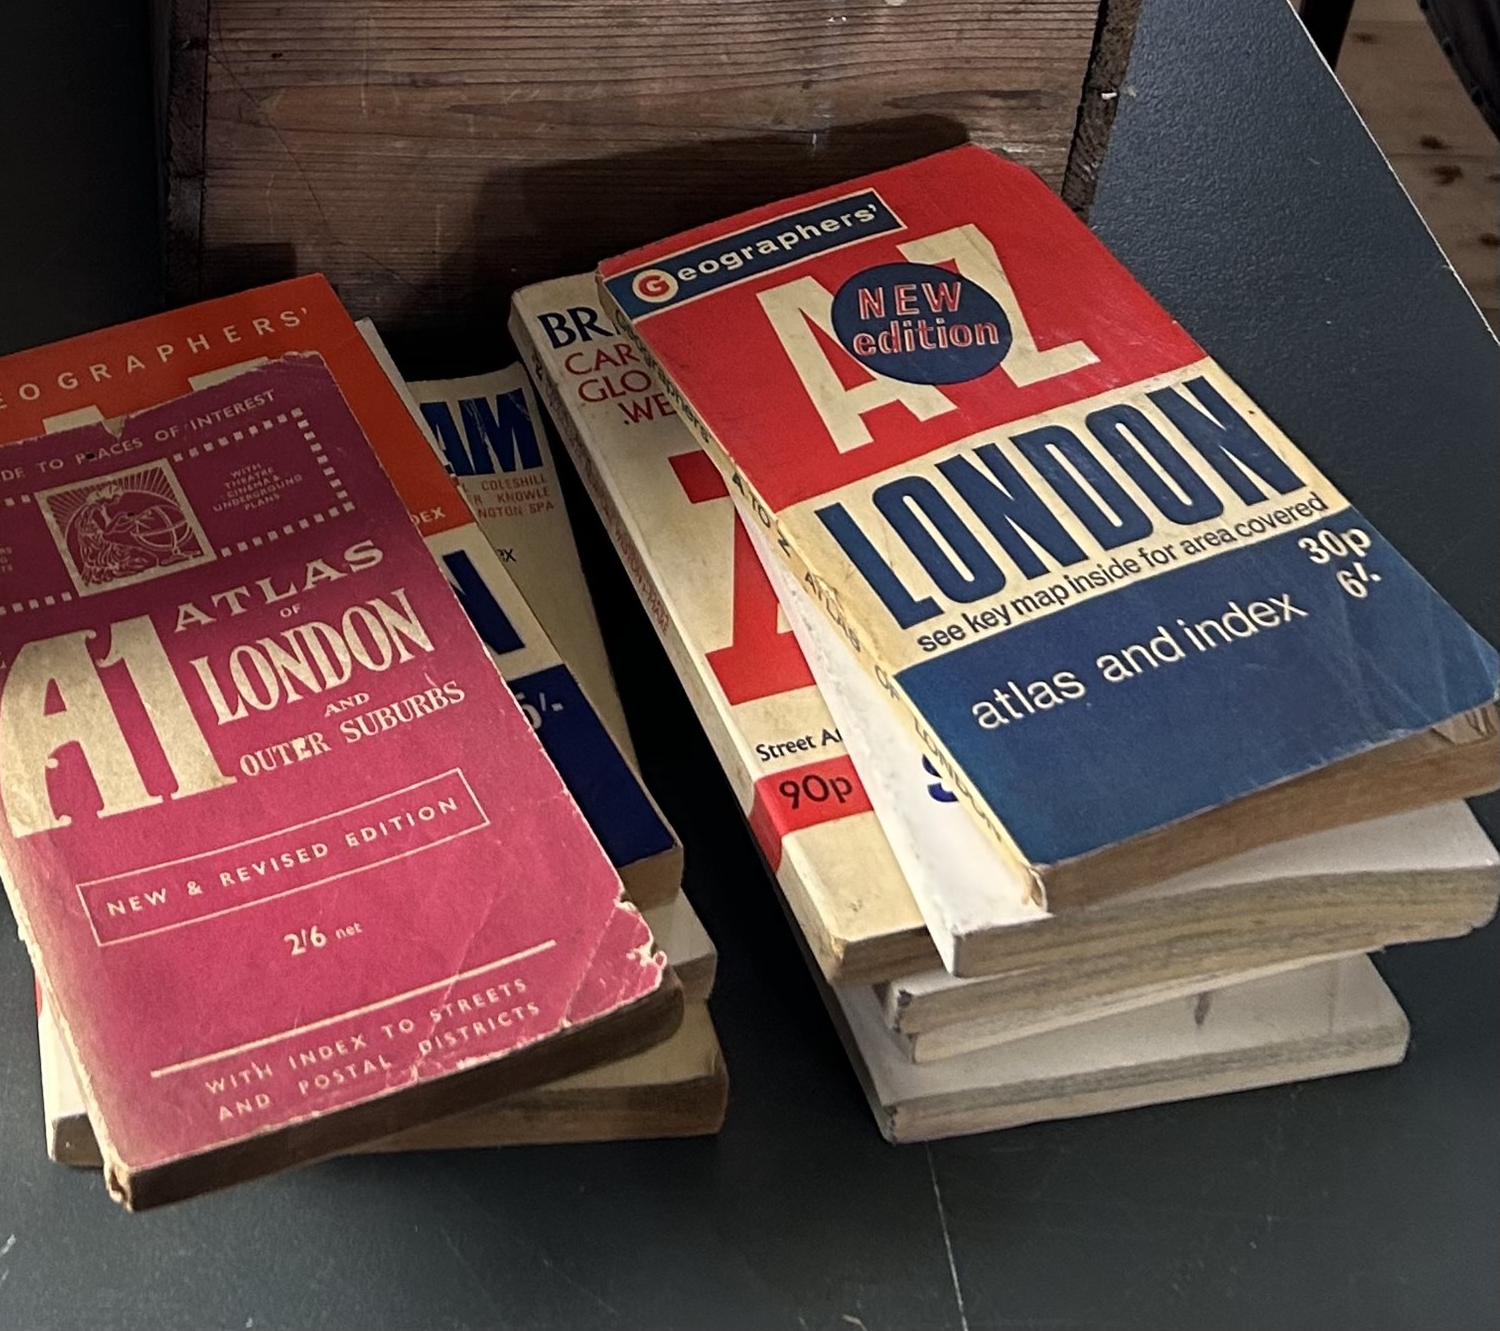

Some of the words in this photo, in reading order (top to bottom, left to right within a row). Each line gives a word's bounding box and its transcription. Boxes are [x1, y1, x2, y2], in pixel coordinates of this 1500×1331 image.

[636, 202, 878, 298] Geographers'
[858, 281, 962, 320] NEW
[853, 317, 1000, 357] edition
[37, 457, 65, 474] TO
[154, 425, 181, 443] OF
[188, 388, 276, 431] INTEREST
[224, 467, 275, 489] THEATRE
[226, 477, 270, 499] CINEMA
[230, 463, 262, 478] WITH
[481, 474, 549, 492] COLESHILL
[213, 474, 303, 512] UNDERGROUND
[244, 493, 281, 511] PLANS
[497, 489, 550, 504] KNOWLE
[529, 501, 555, 515] SPA
[814, 374, 1308, 629] LONDON
[1297, 526, 1373, 566] 30p
[172, 538, 385, 634] ATLAS
[917, 620, 966, 653] see
[968, 604, 1012, 643] key
[1013, 583, 1071, 622] map
[1069, 556, 1142, 597] inside
[1137, 542, 1178, 569] for
[1181, 529, 1234, 554] area
[1233, 491, 1329, 538] covered
[279, 602, 302, 619] OF
[189, 588, 436, 726] LONDON
[972, 665, 1086, 731] atlas
[1096, 629, 1187, 683] and
[1179, 590, 1309, 652] index
[323, 691, 370, 718] AND
[239, 732, 330, 778] OUTER
[340, 680, 466, 744] SUBURBS
[755, 733, 816, 762] Street
[778, 774, 853, 810] 90p
[106, 887, 169, 918] NEW
[187, 880, 204, 897] &
[220, 842, 329, 889] REVISED
[345, 796, 459, 850] EDITION
[335, 921, 363, 940] net
[205, 1061, 273, 1095] WITH
[288, 1036, 368, 1071] INDEX
[381, 1019, 414, 1040] TO
[429, 977, 528, 1022] STREETS
[217, 1091, 273, 1122] AND
[297, 1054, 393, 1096] POSTAL
[418, 1000, 541, 1058] DISTRICTS
